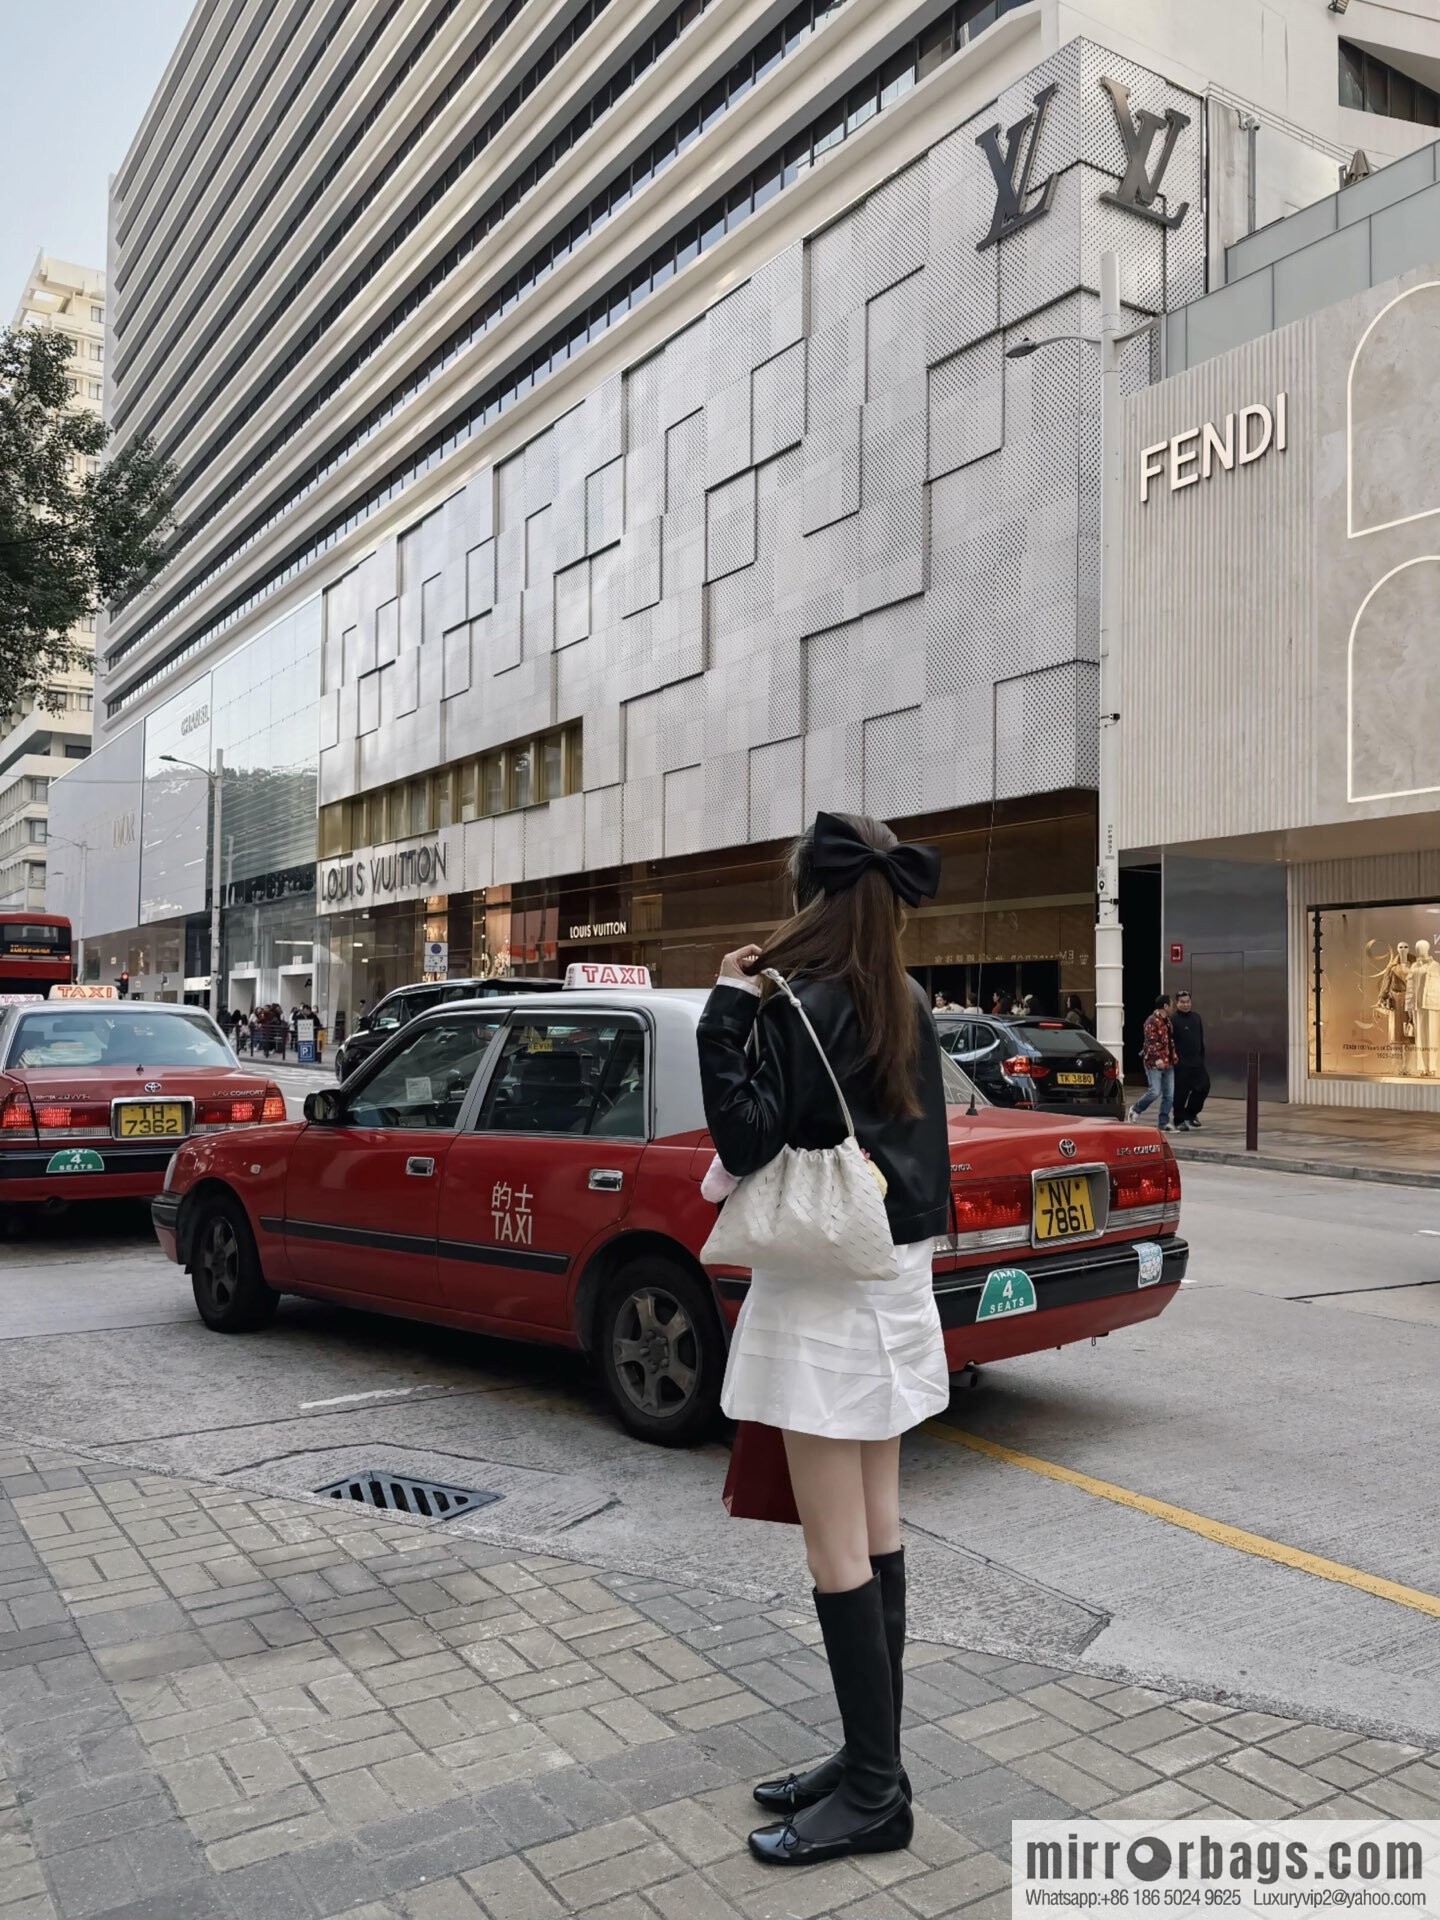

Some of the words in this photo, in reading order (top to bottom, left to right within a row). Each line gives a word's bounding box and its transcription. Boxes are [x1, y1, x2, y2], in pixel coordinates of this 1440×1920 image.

[1139, 391, 1288, 503] FENDI
[321, 861, 366, 901] LOUIS
[369, 841, 447, 893] VUITTON
[569, 924, 592, 939] LOUIS
[593, 921, 627, 937] VUITTON
[582, 965, 646, 985] TAXI
[57, 986, 113, 999] TAXI
[1059, 1074, 1070, 1082] TK
[229, 1089, 265, 1097] COMFORT
[138, 1105, 165, 1119] TH
[125, 1119, 179, 1134] 7362
[70, 1153, 82, 1164] 4
[1117, 1147, 1132, 1156] LPG
[491, 1180, 534, 1213] 的士
[1048, 1179, 1073, 1208] NV
[491, 1210, 533, 1245] TAXI
[1041, 1206, 1088, 1236] 7861
[1002, 1280, 1014, 1299] 4
[989, 1297, 1025, 1314] SEATS
